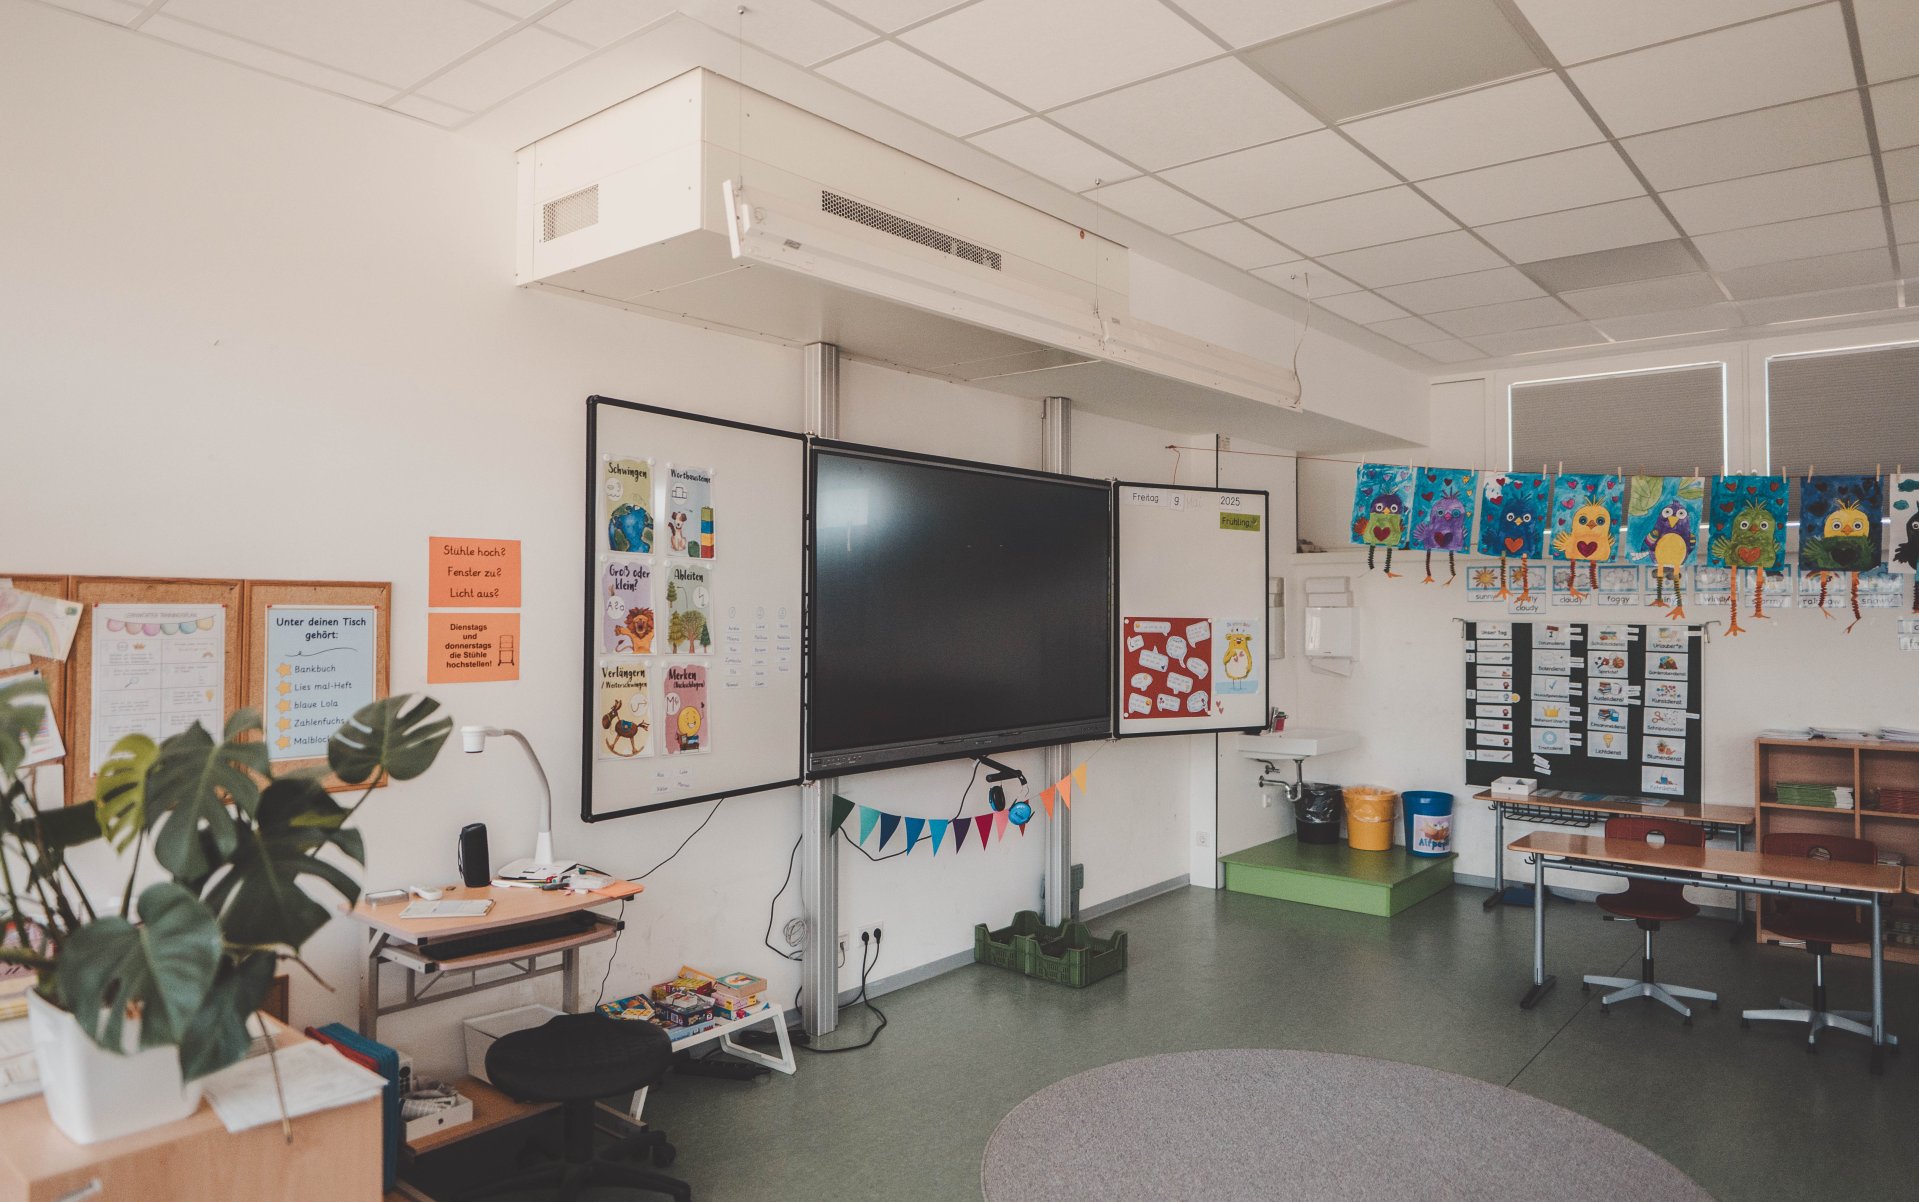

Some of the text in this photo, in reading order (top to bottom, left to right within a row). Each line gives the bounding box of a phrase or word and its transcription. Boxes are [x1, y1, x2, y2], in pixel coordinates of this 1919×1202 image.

[608, 462, 648, 482] Schwingen
[1132, 492, 1159, 503] Freitag
[1220, 496, 1240, 506] 2025
[443, 545, 506, 557] Stühle hoch?
[448, 566, 502, 578] Fenster zu?
[609, 564, 651, 578] Groß oder
[674, 568, 704, 582] Ableiten
[615, 578, 639, 592] klein?
[450, 588, 499, 598] Licht aus?
[1607, 594, 1631, 605] foggy
[276, 617, 366, 626] Unter deinen Tisch
[450, 624, 488, 632] Dienstags
[305, 631, 338, 642] gehört:
[445, 642, 492, 650] donnerstags
[464, 650, 488, 658] Stühle
[294, 665, 336, 674] Bankbuch
[446, 660, 492, 668] hochstellen!
[602, 666, 646, 682] Verlängern
[668, 668, 697, 681] Merken
[294, 682, 352, 692] Lies mal-Heft
[294, 700, 338, 709] blaue Lola
[294, 717, 345, 728] Zahlenfuchs
